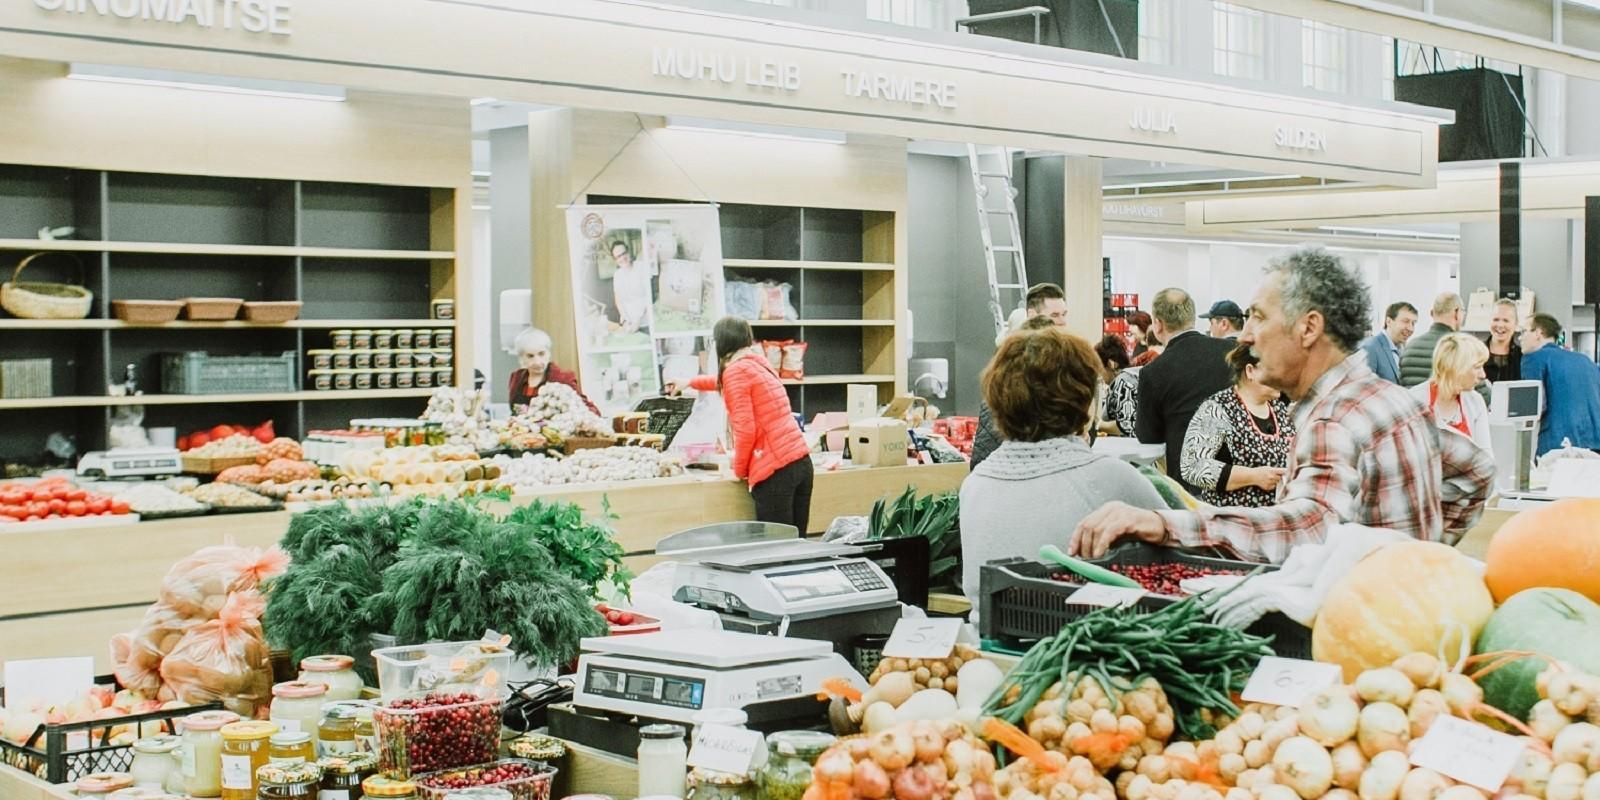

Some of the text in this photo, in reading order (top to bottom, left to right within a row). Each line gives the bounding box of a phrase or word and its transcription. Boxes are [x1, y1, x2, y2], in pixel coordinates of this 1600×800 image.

[34, 0, 292, 35] UMAITSE
[652, 47, 801, 91] MUHU LEIB
[841, 67, 958, 109] TARMERE
[1129, 105, 1177, 135] JULIA
[1275, 126, 1327, 152] SILDEN
